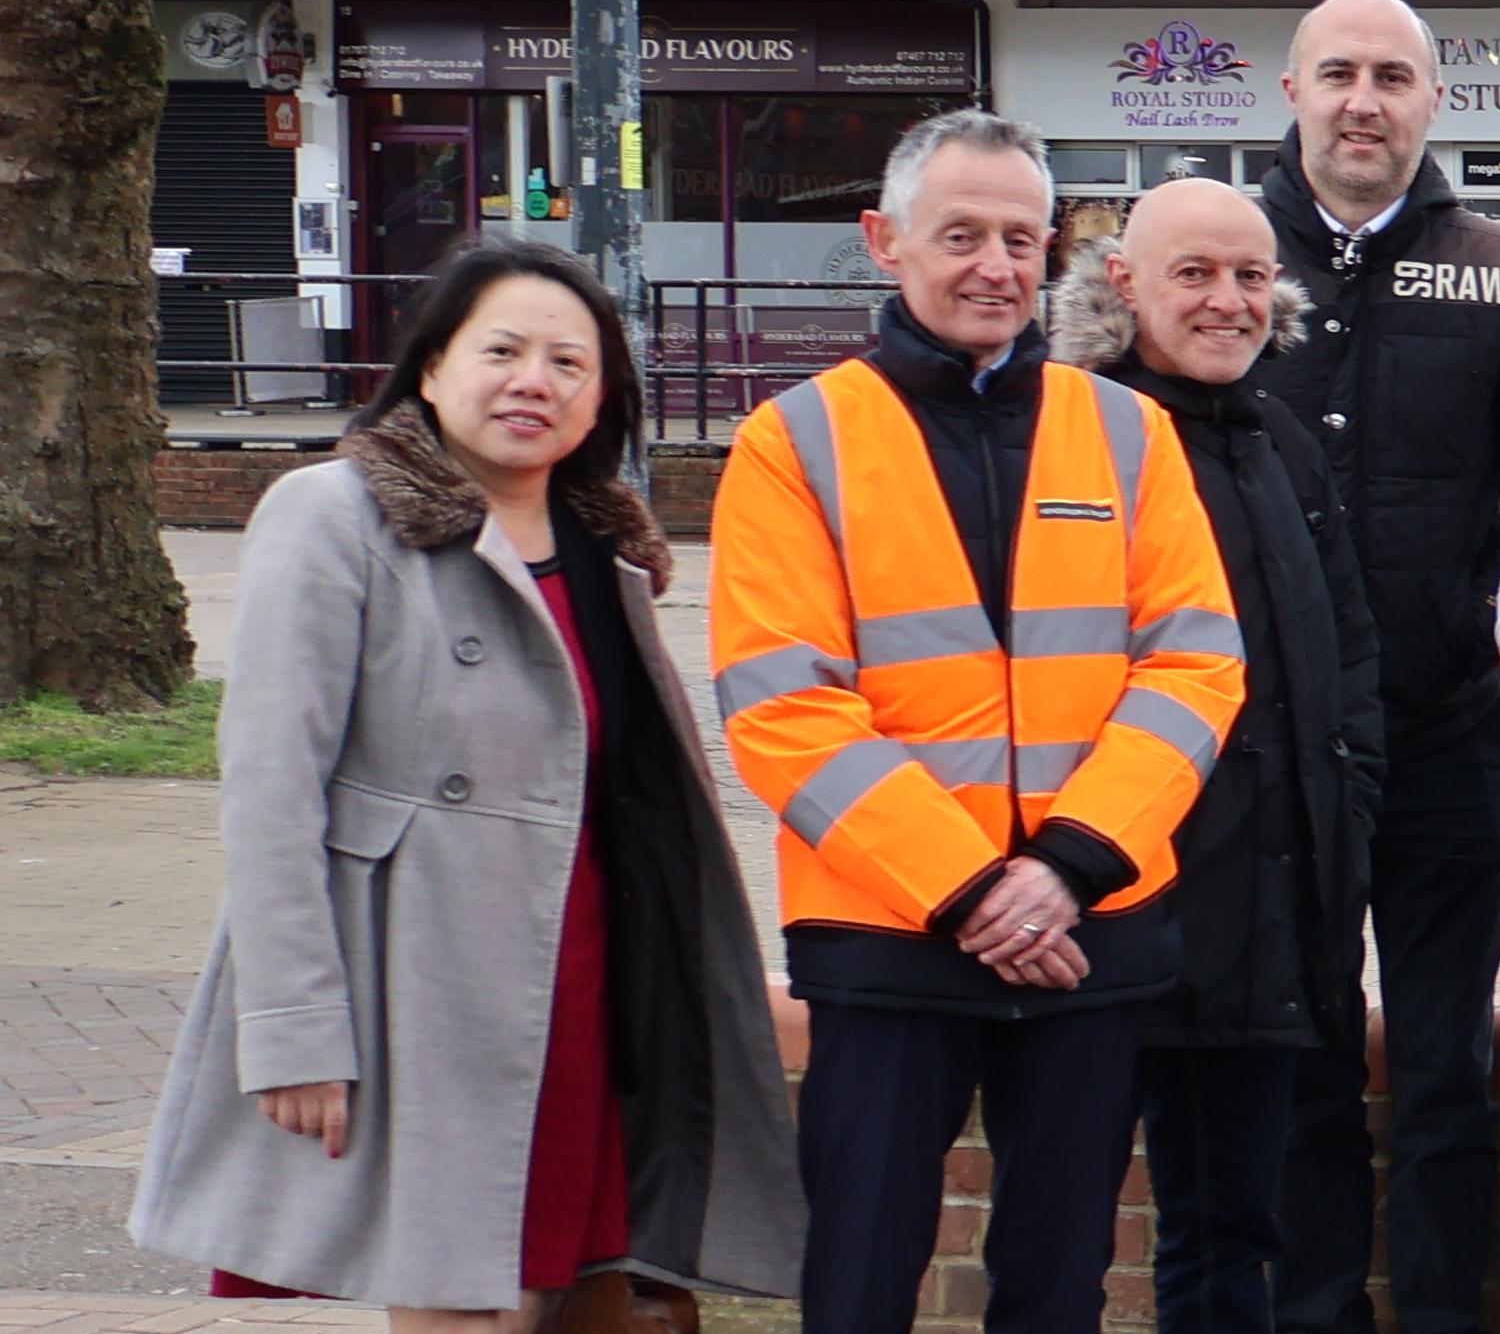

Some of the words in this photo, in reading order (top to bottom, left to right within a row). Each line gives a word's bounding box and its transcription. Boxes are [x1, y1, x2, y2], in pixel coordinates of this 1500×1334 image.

[507, 37, 660, 60] HYDED
[666, 38, 795, 61] FLAVOURS
[1168, 30, 1191, 55] R
[1111, 91, 1176, 107] ROYAL
[1181, 91, 1257, 108] STUDIO
[1125, 109, 1158, 127] Nail
[1162, 110, 1198, 127] Lash
[1201, 113, 1240, 127] Brow
